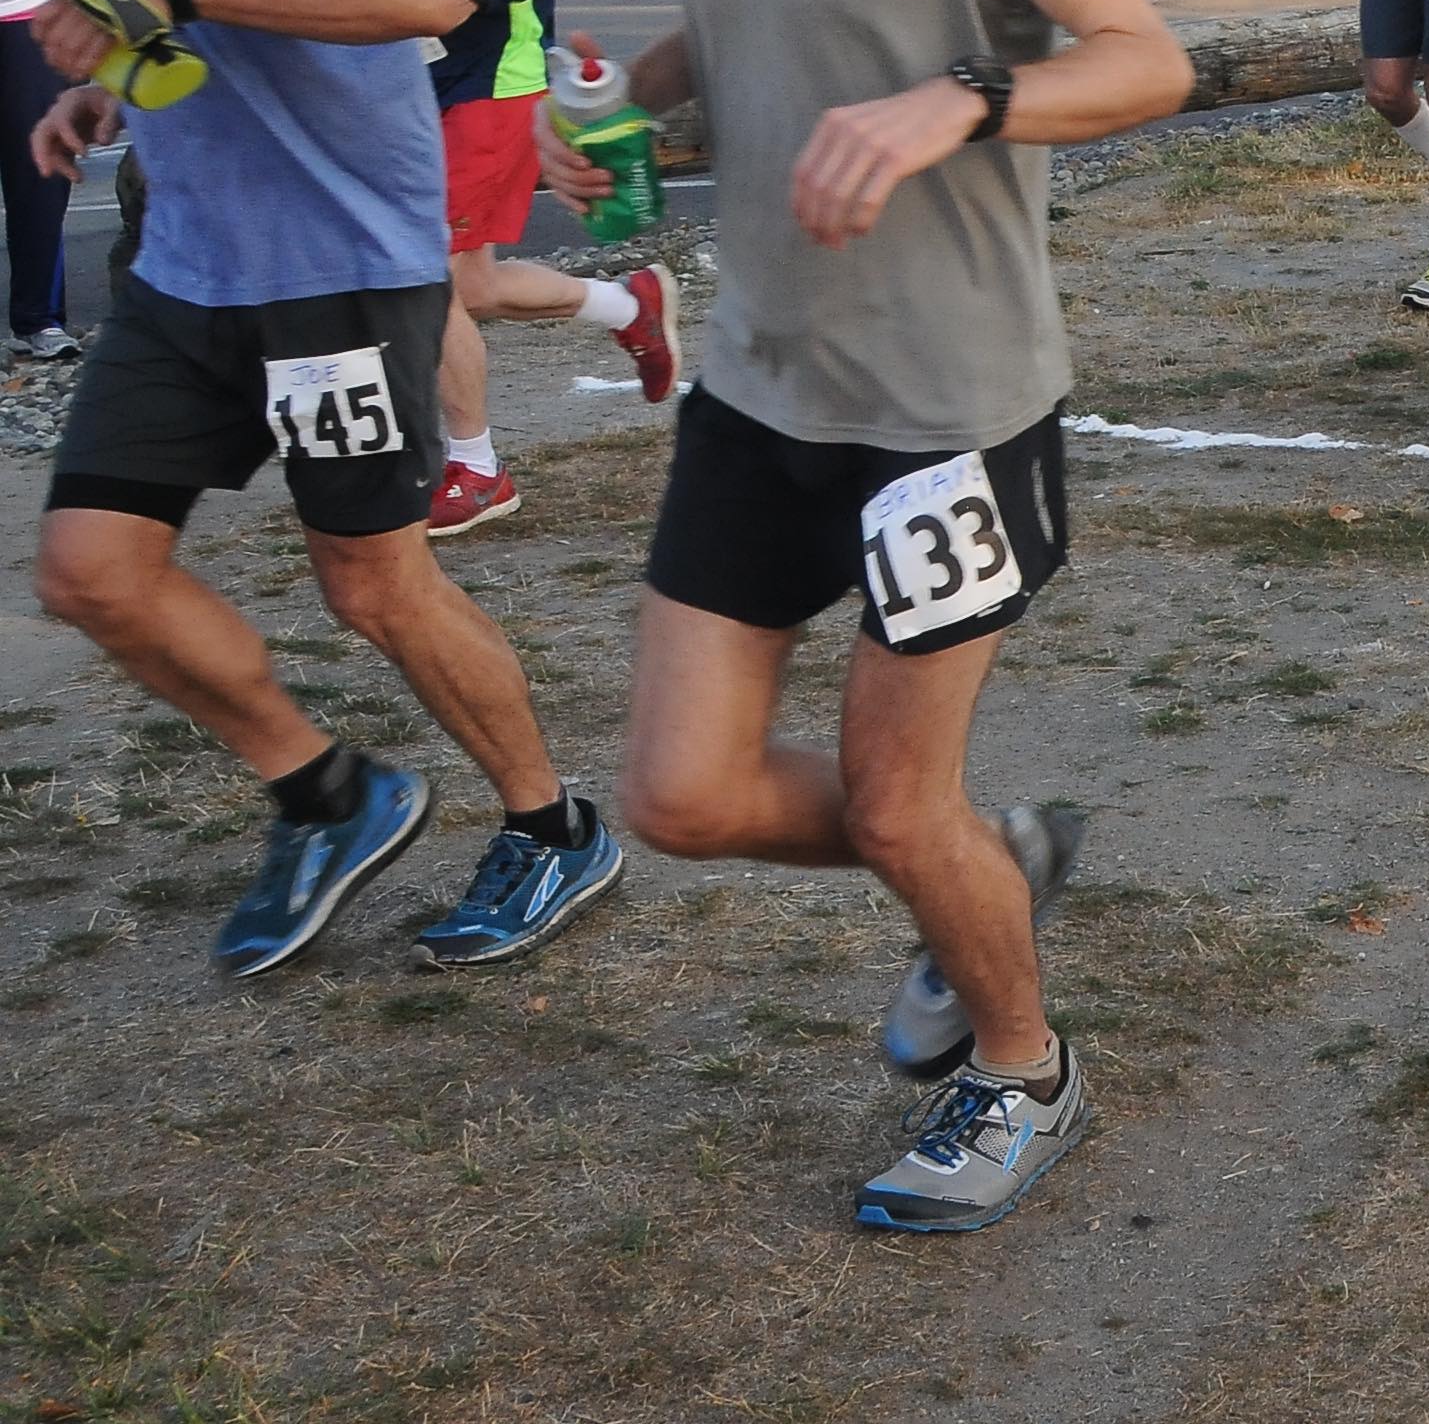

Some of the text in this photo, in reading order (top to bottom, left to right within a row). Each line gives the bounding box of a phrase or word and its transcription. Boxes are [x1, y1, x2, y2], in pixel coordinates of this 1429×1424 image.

[289, 363, 341, 386] JOE
[275, 383, 389, 457] 145
[864, 496, 1007, 617] 133
